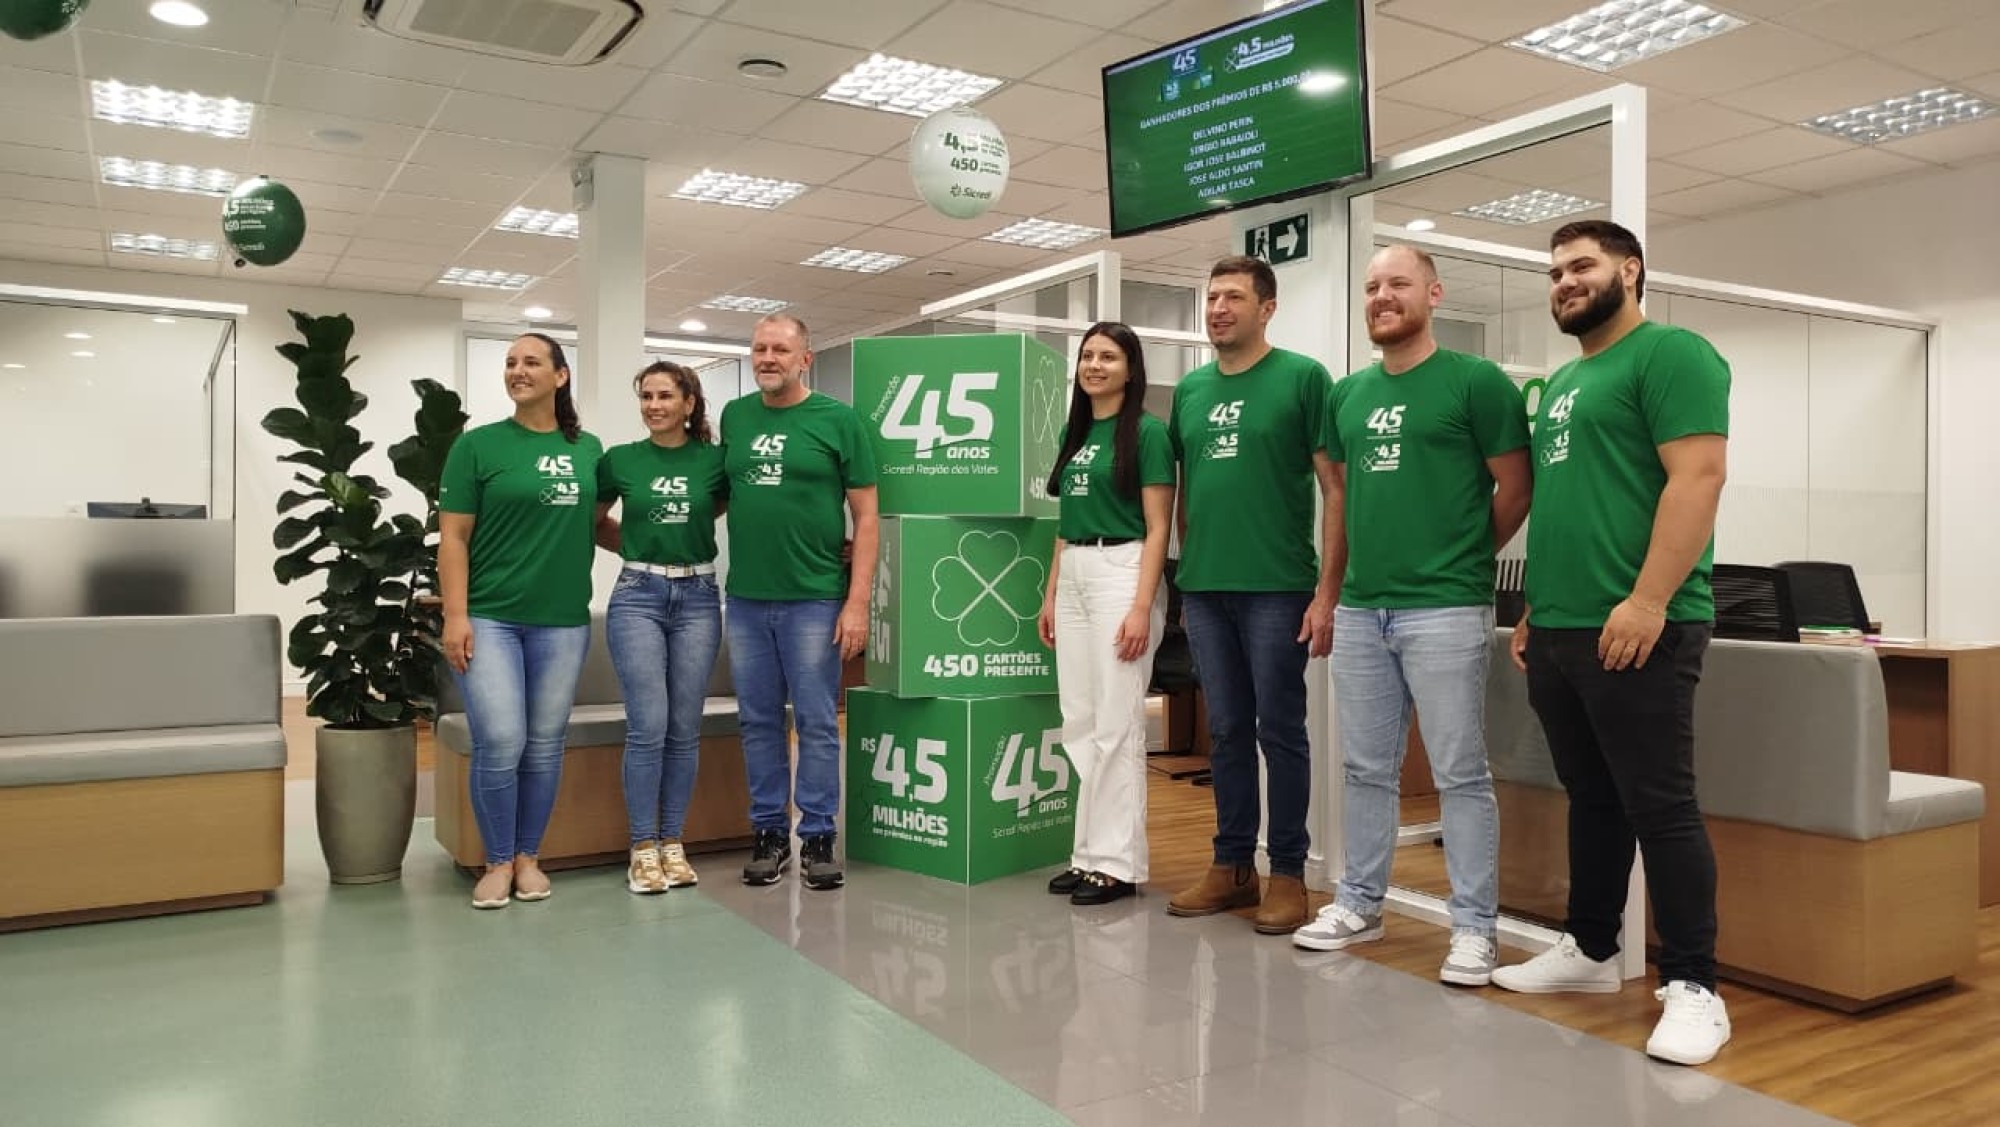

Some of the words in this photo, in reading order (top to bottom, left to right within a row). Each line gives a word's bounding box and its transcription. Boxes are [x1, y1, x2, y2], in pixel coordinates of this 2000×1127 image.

[1172, 48, 1197, 71] 45
[1140, 106, 1193, 129] GANHADORES
[1193, 100, 1211, 114] DOS
[1211, 90, 1248, 109] PRÊMIOS
[1249, 86, 1261, 99] DE
[1261, 81, 1274, 94] R$
[950, 157, 979, 171] 450
[1209, 167, 1231, 180] ALDO
[880, 371, 999, 459] 45
[1208, 400, 1244, 426] 45
[1367, 405, 1406, 434] 45
[751, 434, 788, 455] 45
[946, 446, 990, 459] anos
[538, 454, 574, 475] 45
[916, 463, 949, 476] Região
[951, 463, 969, 475] dos
[651, 476, 689, 494] 45
[923, 653, 979, 678] 450
[983, 650, 1042, 664] CARTÕES
[984, 665, 1050, 677] PRESENTE
[860, 737, 876, 753] R$
[871, 733, 948, 804] 4,5
[991, 727, 1070, 818] 45
[1039, 797, 1069, 813] anos
[872, 804, 948, 836] MILHÕES
